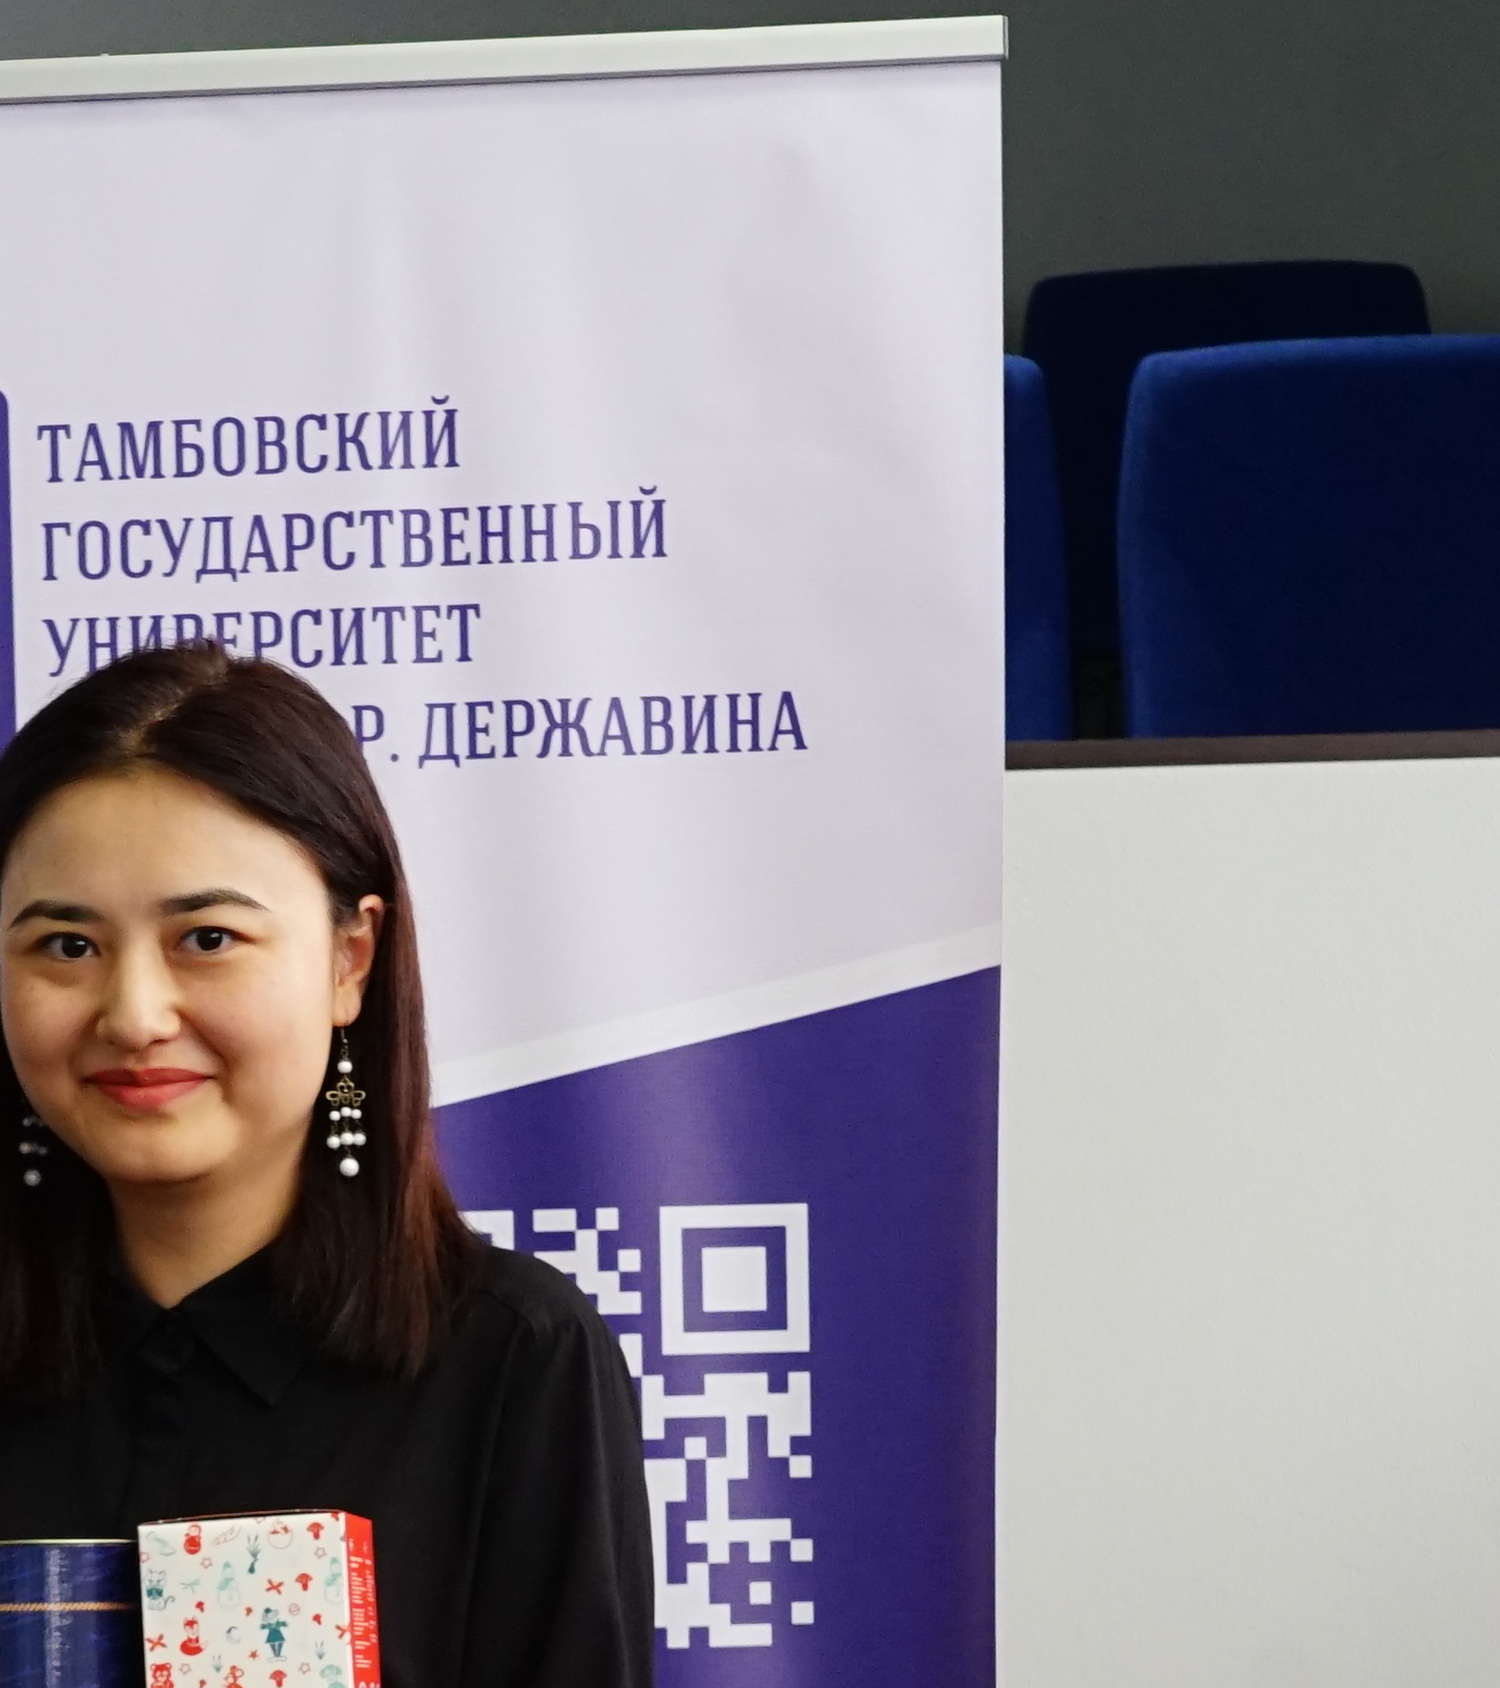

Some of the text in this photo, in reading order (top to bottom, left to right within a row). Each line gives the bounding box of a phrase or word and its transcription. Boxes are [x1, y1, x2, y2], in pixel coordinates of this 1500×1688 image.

[37, 394, 461, 483] ТАМБОВСКИЙ
[42, 485, 667, 584] ГОСУДАРСТВЕННЫЙ
[418, 690, 809, 769] ДЕРЖАВИНА
